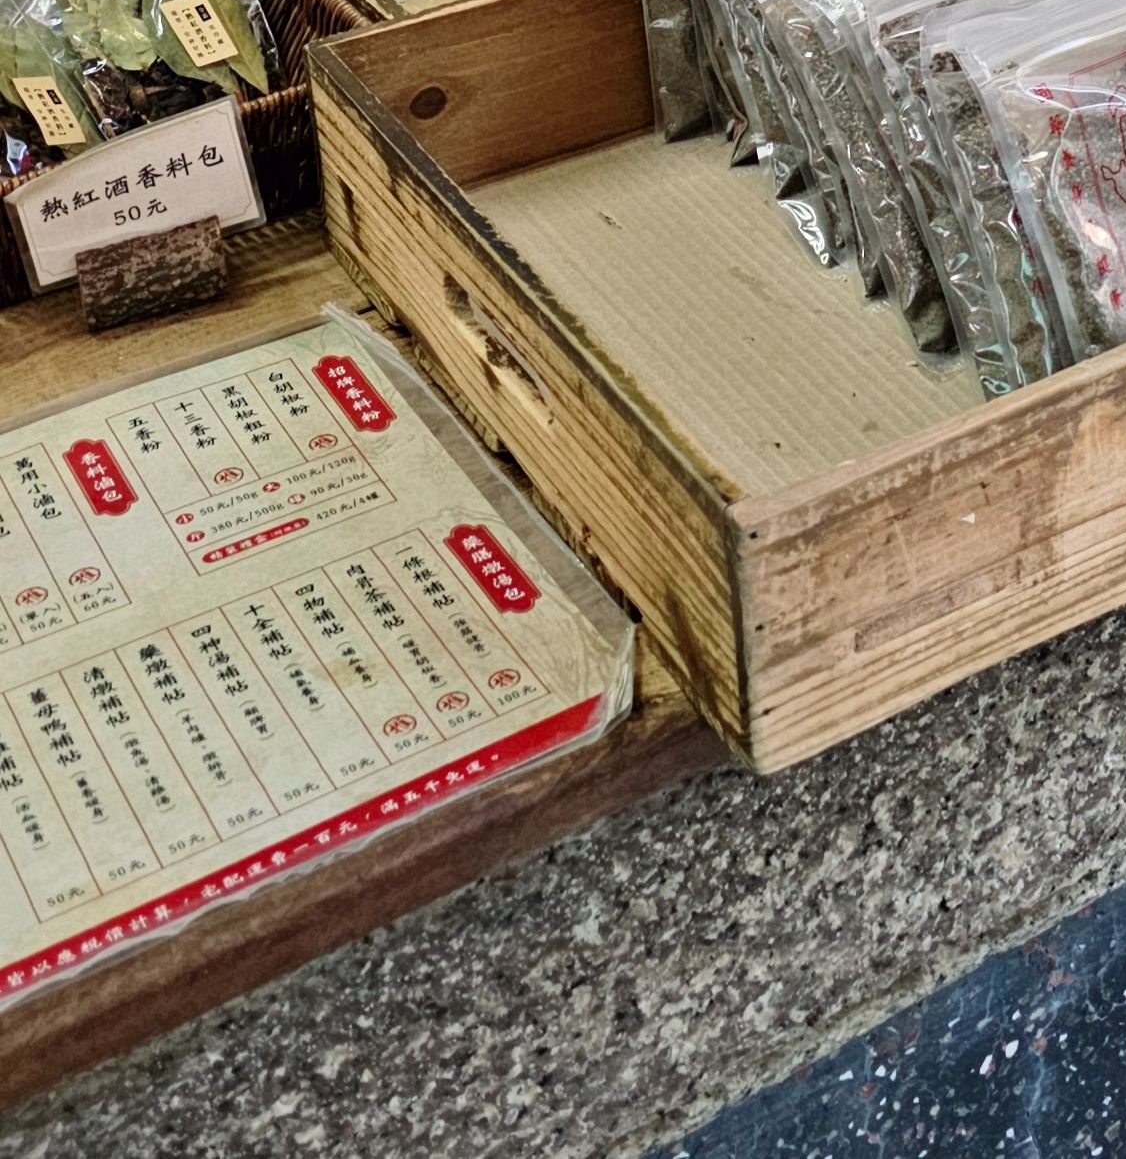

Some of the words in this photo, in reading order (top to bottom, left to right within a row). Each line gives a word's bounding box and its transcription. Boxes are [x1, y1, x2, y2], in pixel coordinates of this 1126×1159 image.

[40, 144, 225, 223] 熱紅酒香料包
[221, 385, 272, 445] 黑胡椒粗粉
[269, 371, 309, 417] 白胡椒粉
[327, 366, 381, 423] 招牌香料粉
[128, 416, 162, 454] 五香粉
[174, 401, 216, 449] 十三香粉
[14, 457, 62, 520] 萬用小滷包
[81, 450, 122, 503] 香料滷包
[346, 564, 404, 632] 肉骨茶補帖
[395, 546, 455, 610] 一條根補帖
[460, 535, 526, 601] 藥膳燉湯包
[243, 603, 292, 661] 十全補帖
[294, 583, 344, 639] 四物補帖
[138, 643, 186, 705] 藥燉補帖
[190, 624, 249, 698] 四神湯補帖
[83, 665, 131, 728] 清燉補帖
